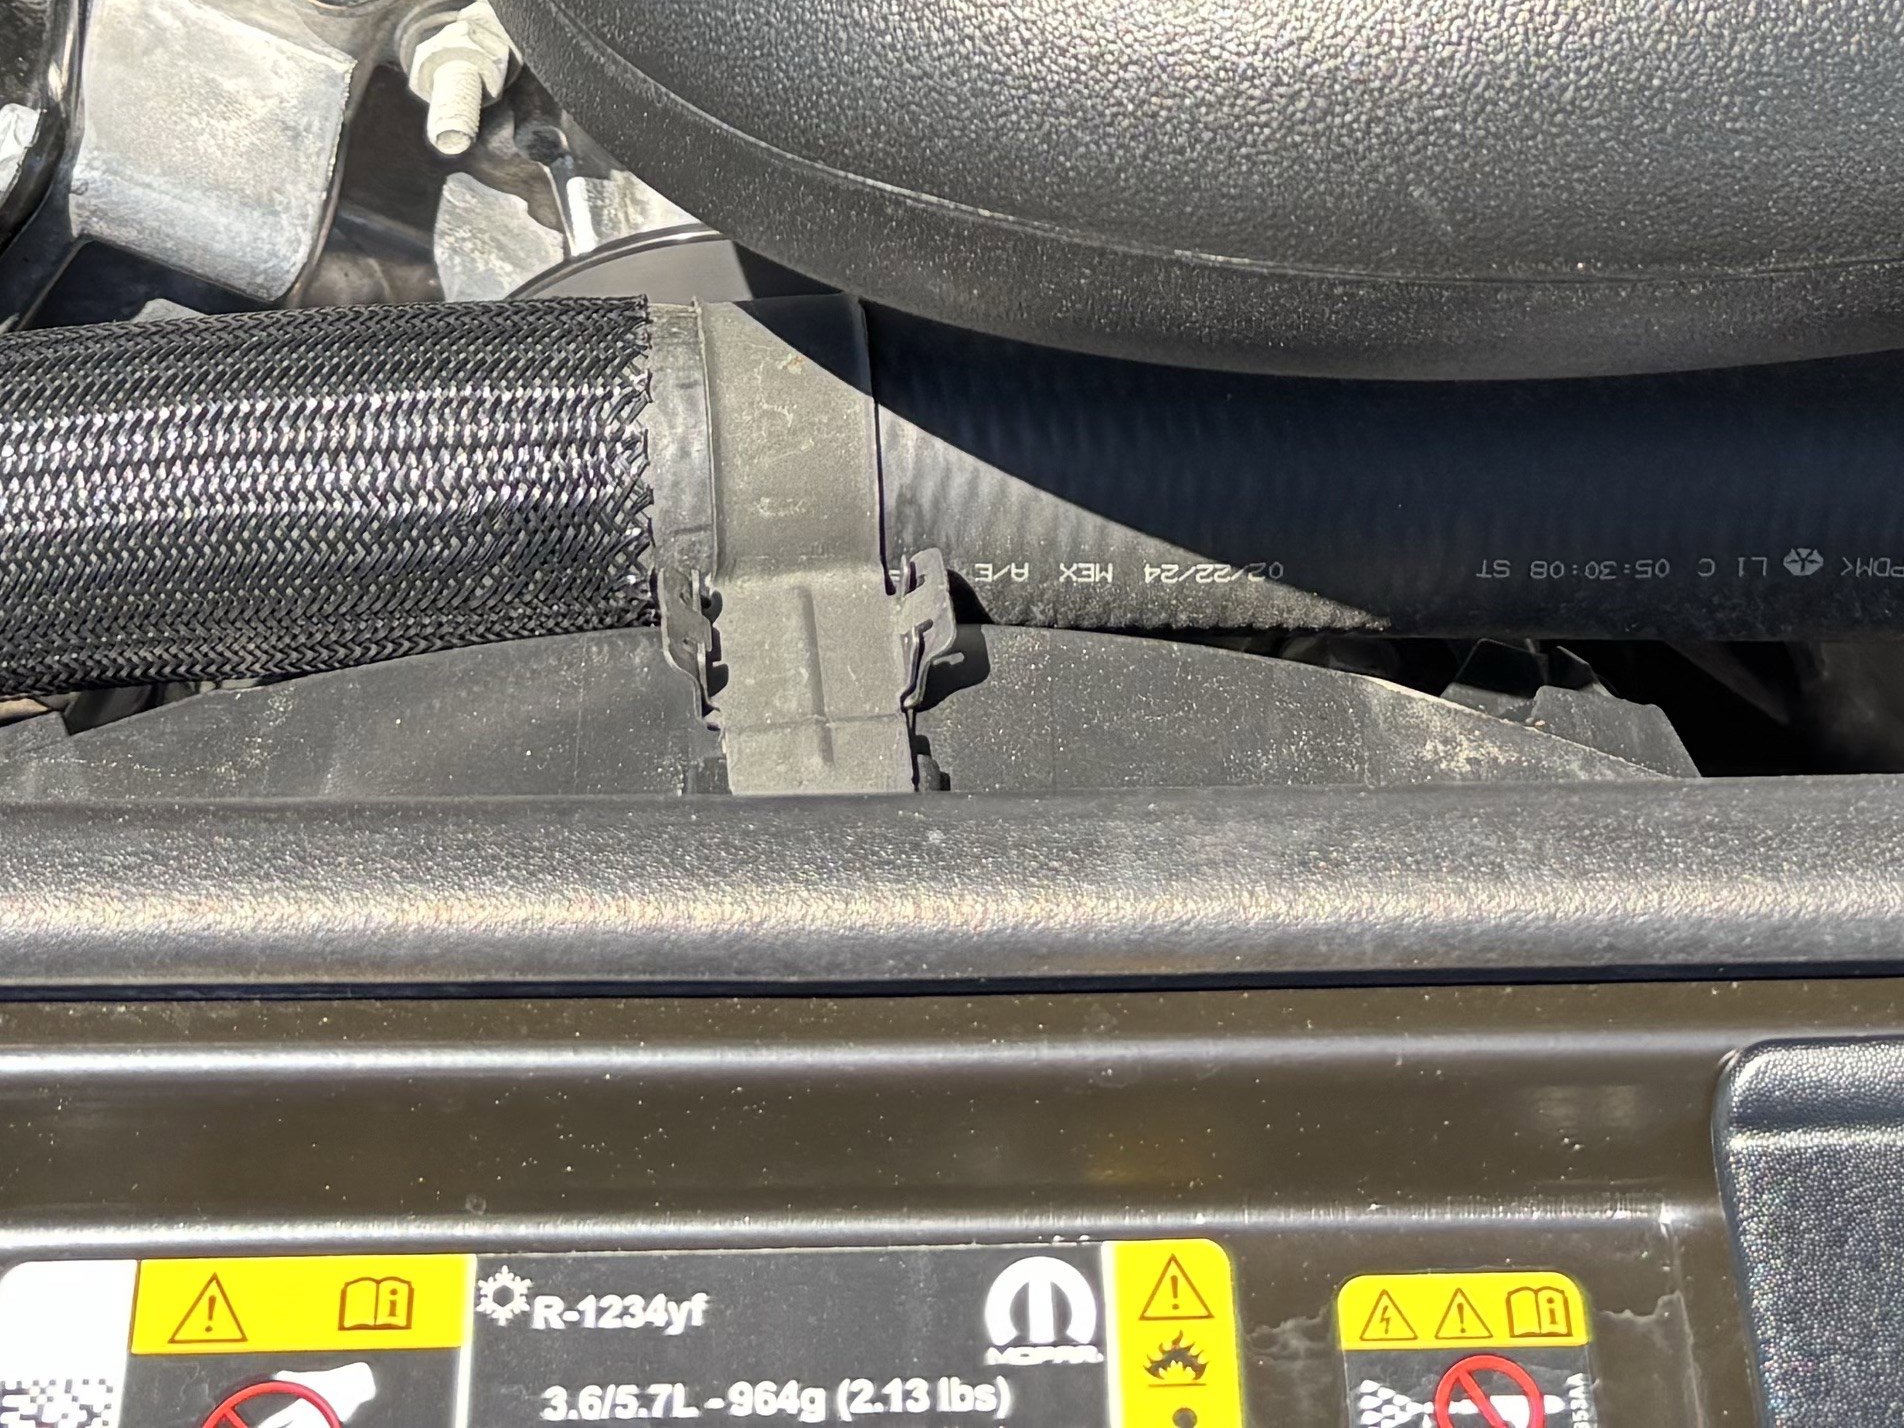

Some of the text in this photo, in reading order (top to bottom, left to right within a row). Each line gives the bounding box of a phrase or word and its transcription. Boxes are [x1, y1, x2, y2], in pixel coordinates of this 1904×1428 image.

[973, 562, 1030, 584] A/E
[1058, 562, 1114, 584] MEX
[1143, 560, 1284, 584] 02/22/24
[1475, 558, 1512, 579] ST
[1529, 558, 1671, 580] 05:30:08
[1697, 557, 1716, 578] C
[530, 1292, 711, 1335] R-1234yf
[539, 1382, 701, 1421] 3.6/5.7L
[728, 1379, 826, 1423] 964g
[836, 1377, 930, 1422] (2.13
[936, 1376, 1014, 1420] lbs)
